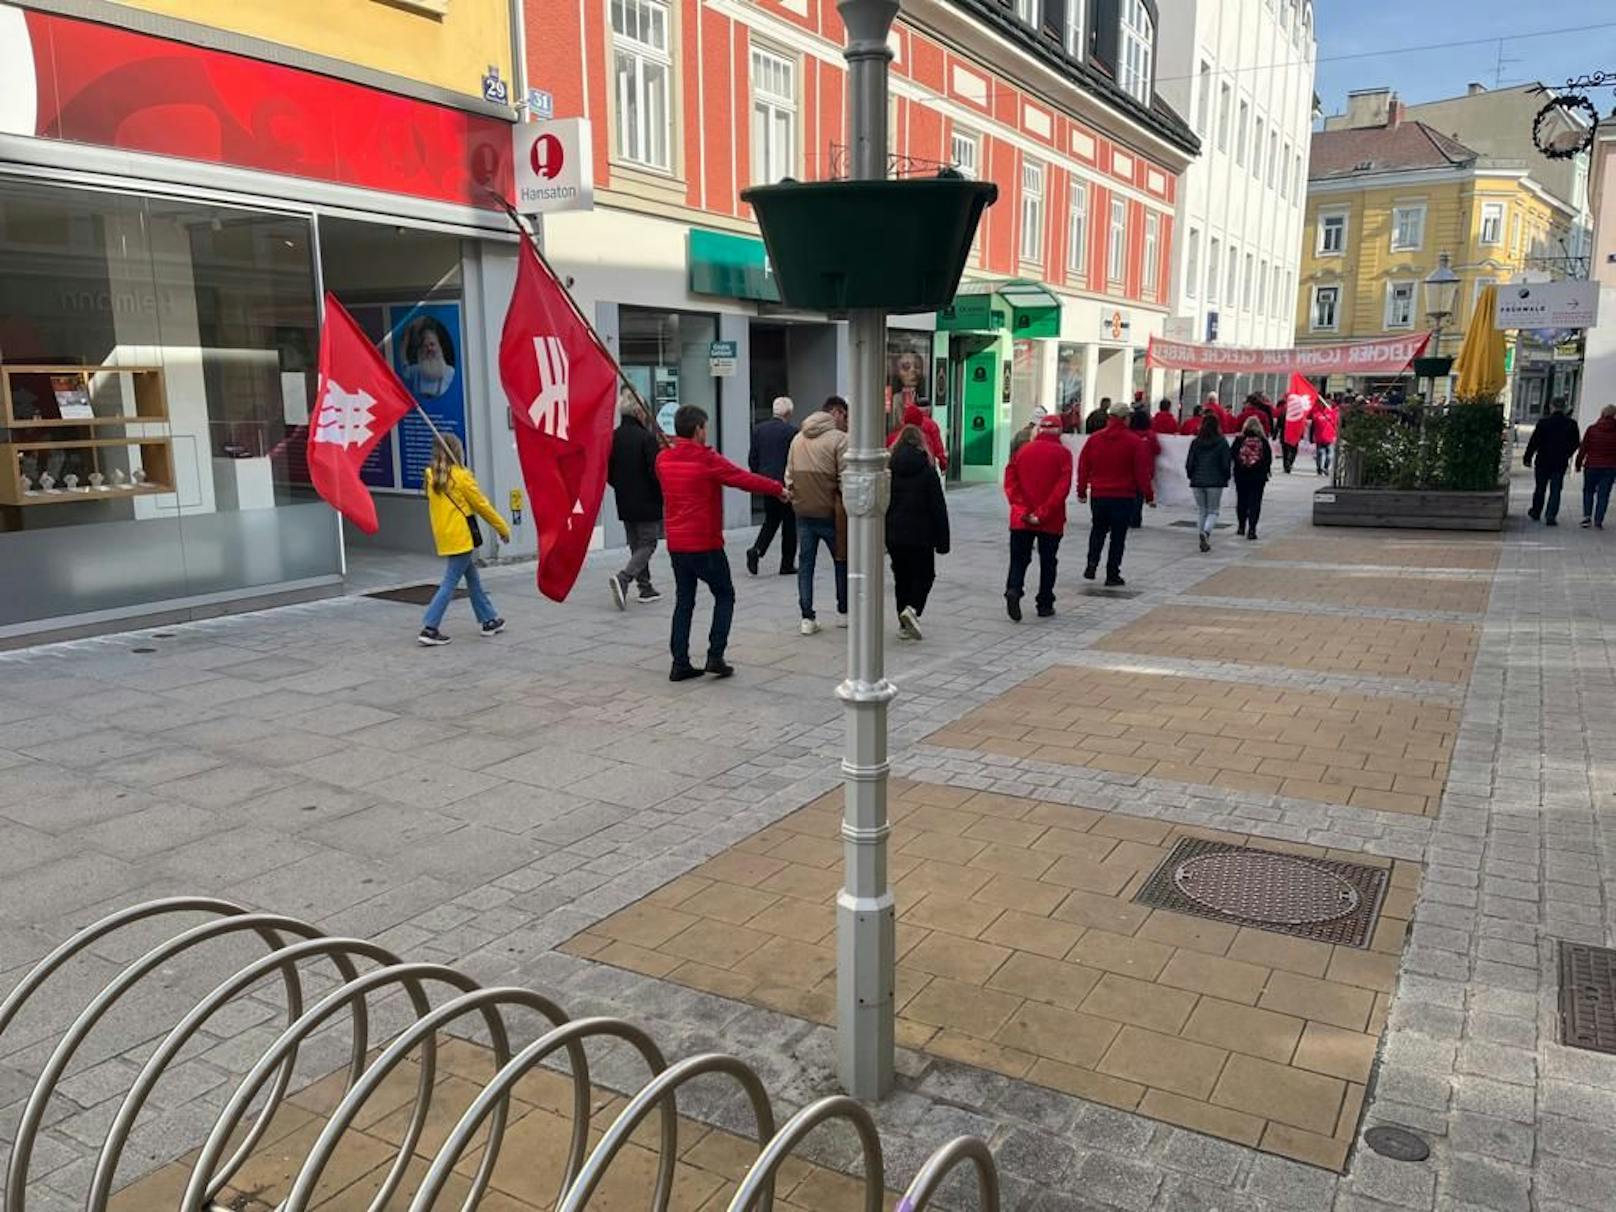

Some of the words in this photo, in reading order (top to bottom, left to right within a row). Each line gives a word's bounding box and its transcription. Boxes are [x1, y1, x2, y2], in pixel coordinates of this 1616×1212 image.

[487, 79, 505, 98] 29
[534, 92, 548, 109] 31
[521, 185, 577, 201] Hansaton
